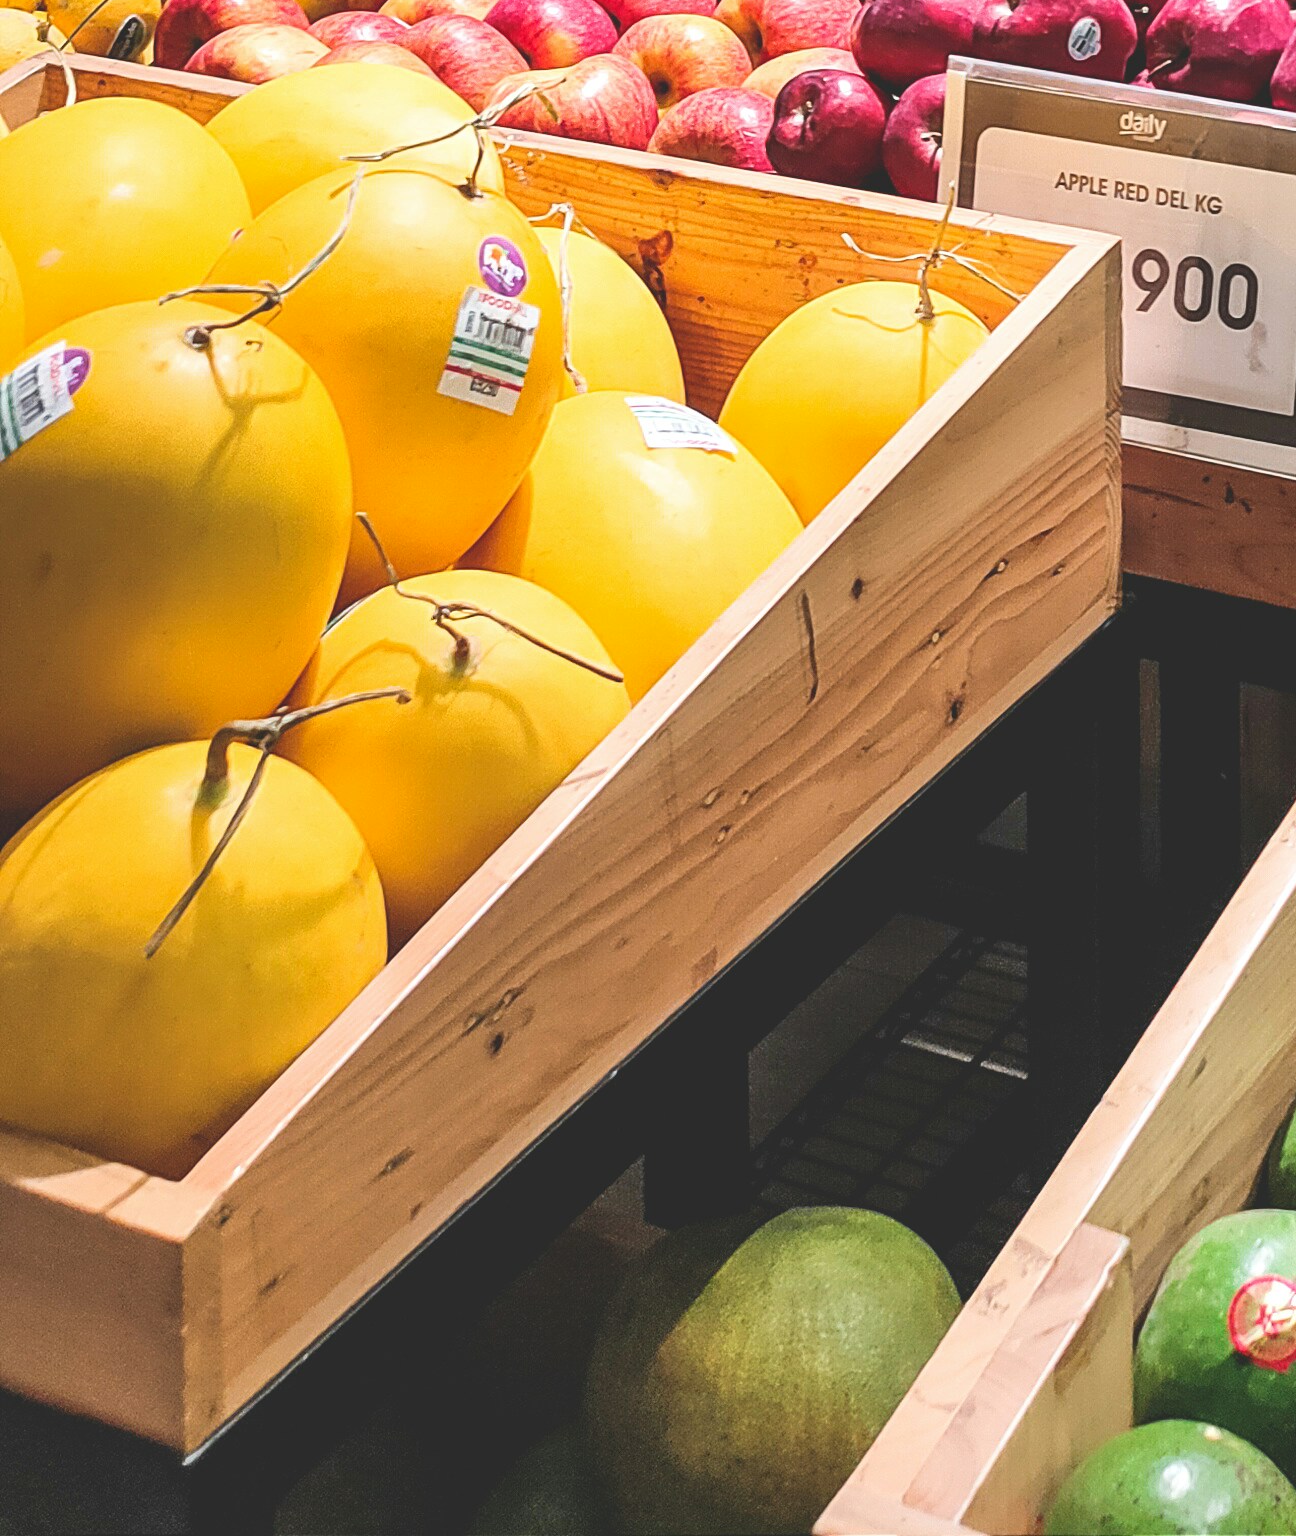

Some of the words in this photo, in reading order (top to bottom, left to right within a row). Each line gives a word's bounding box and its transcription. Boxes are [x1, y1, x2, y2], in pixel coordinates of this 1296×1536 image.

[1119, 111, 1167, 142] daily
[1055, 171, 1108, 197] APPLE
[1113, 180, 1150, 203] RED
[1155, 188, 1190, 210] DEL
[1194, 193, 1223, 215] KG
